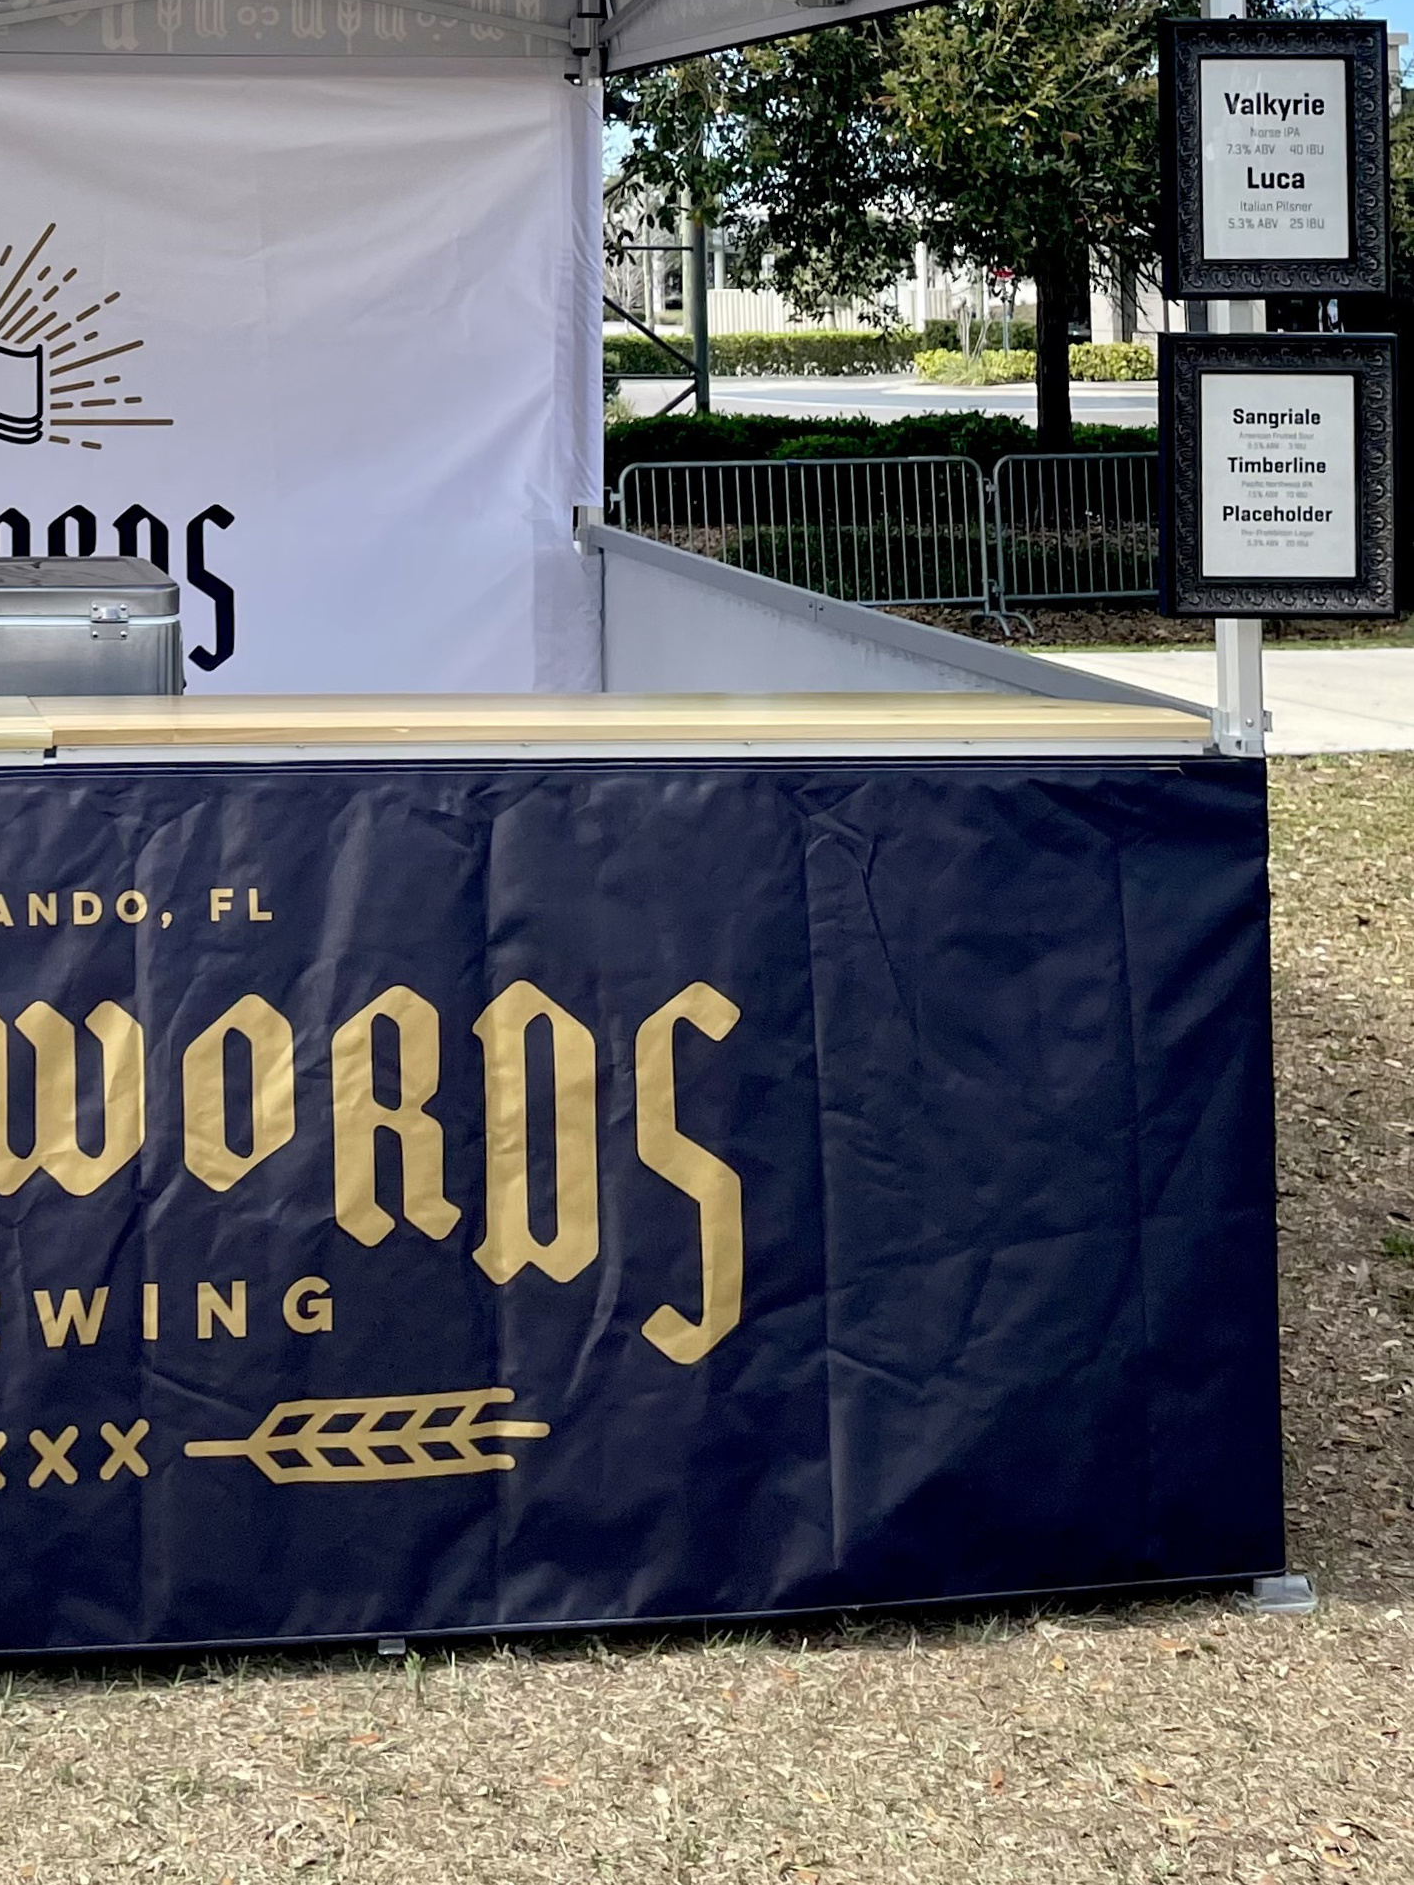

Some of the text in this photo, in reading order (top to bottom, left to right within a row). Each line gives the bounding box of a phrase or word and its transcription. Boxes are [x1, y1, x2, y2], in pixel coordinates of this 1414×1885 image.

[1224, 91, 1325, 121] Valkyrie
[1250, 127, 1300, 137] Norse IPA
[1255, 144, 1276, 155] ABV
[1289, 144, 1303, 155] 40
[1306, 144, 1324, 155] IBU
[1247, 167, 1305, 189] Luca
[1240, 201, 1312, 212] Italian Pilsner
[1257, 218, 1278, 229] ABV
[1290, 218, 1304, 229] 25
[1307, 218, 1325, 229] IBU
[1233, 408, 1321, 429] Sangriale
[1227, 457, 1326, 474] Timberline
[1222, 505, 1332, 522] Placeholder
[208, 885, 276, 925] FL
